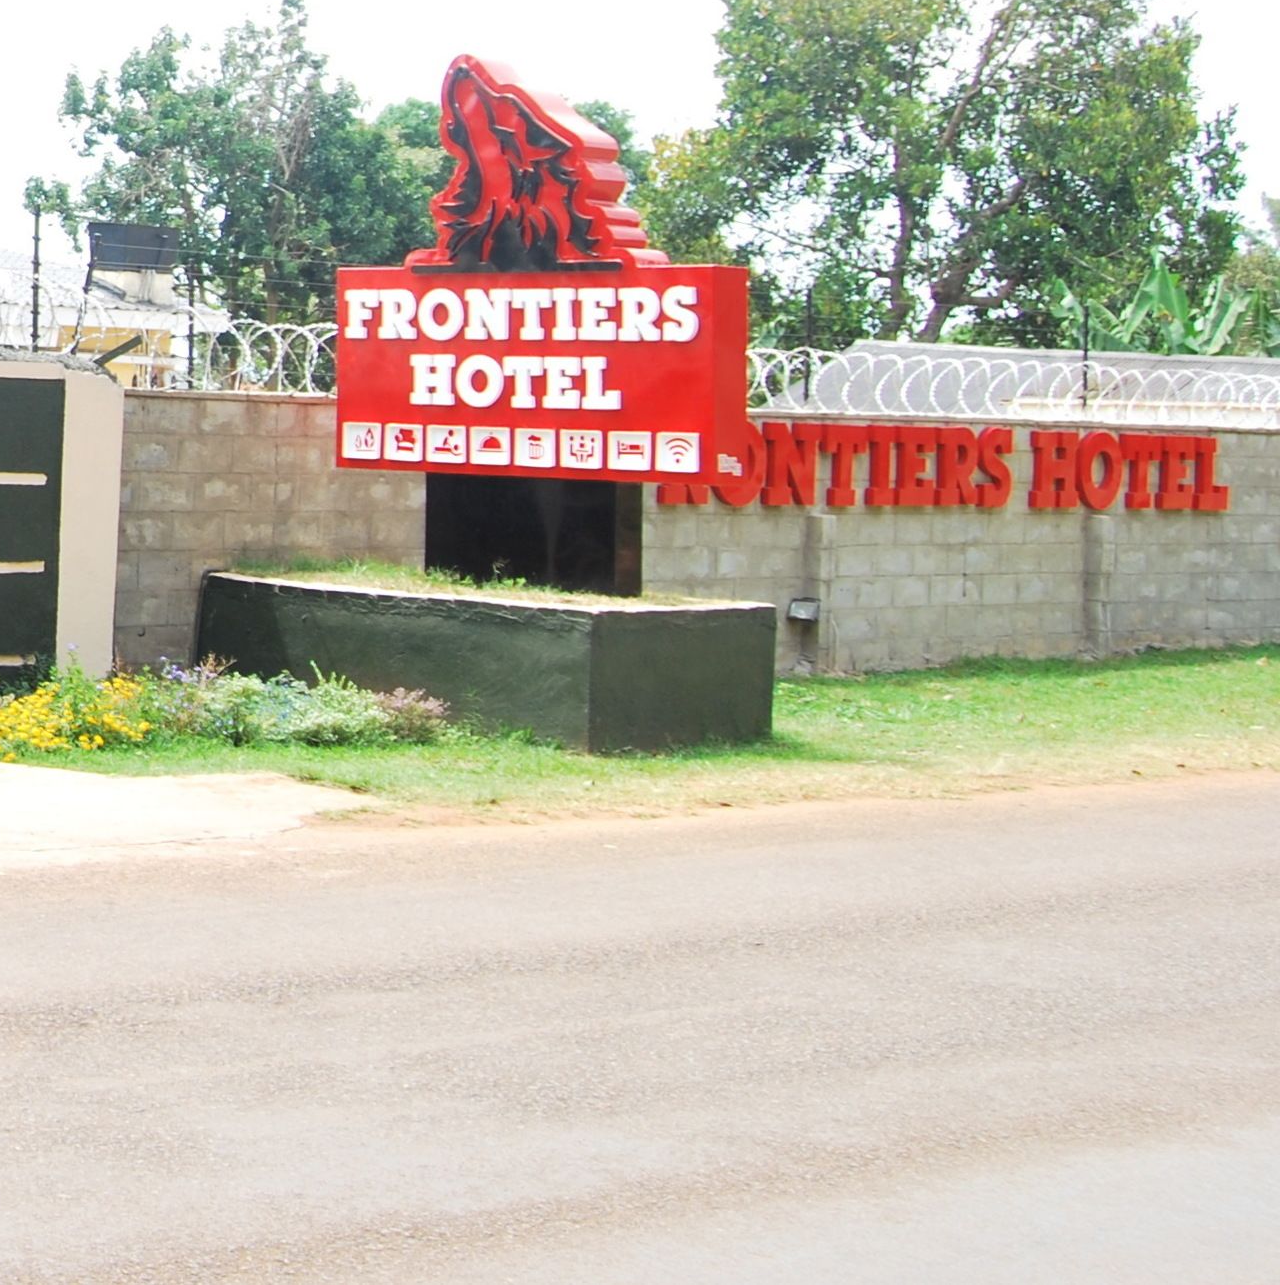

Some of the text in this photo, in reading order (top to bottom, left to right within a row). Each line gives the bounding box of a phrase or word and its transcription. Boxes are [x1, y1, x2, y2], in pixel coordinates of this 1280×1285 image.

[343, 286, 700, 342] FRONTIERS
[409, 353, 622, 410] HOTEL
[657, 421, 1230, 511] ONTIERS HOTEL
